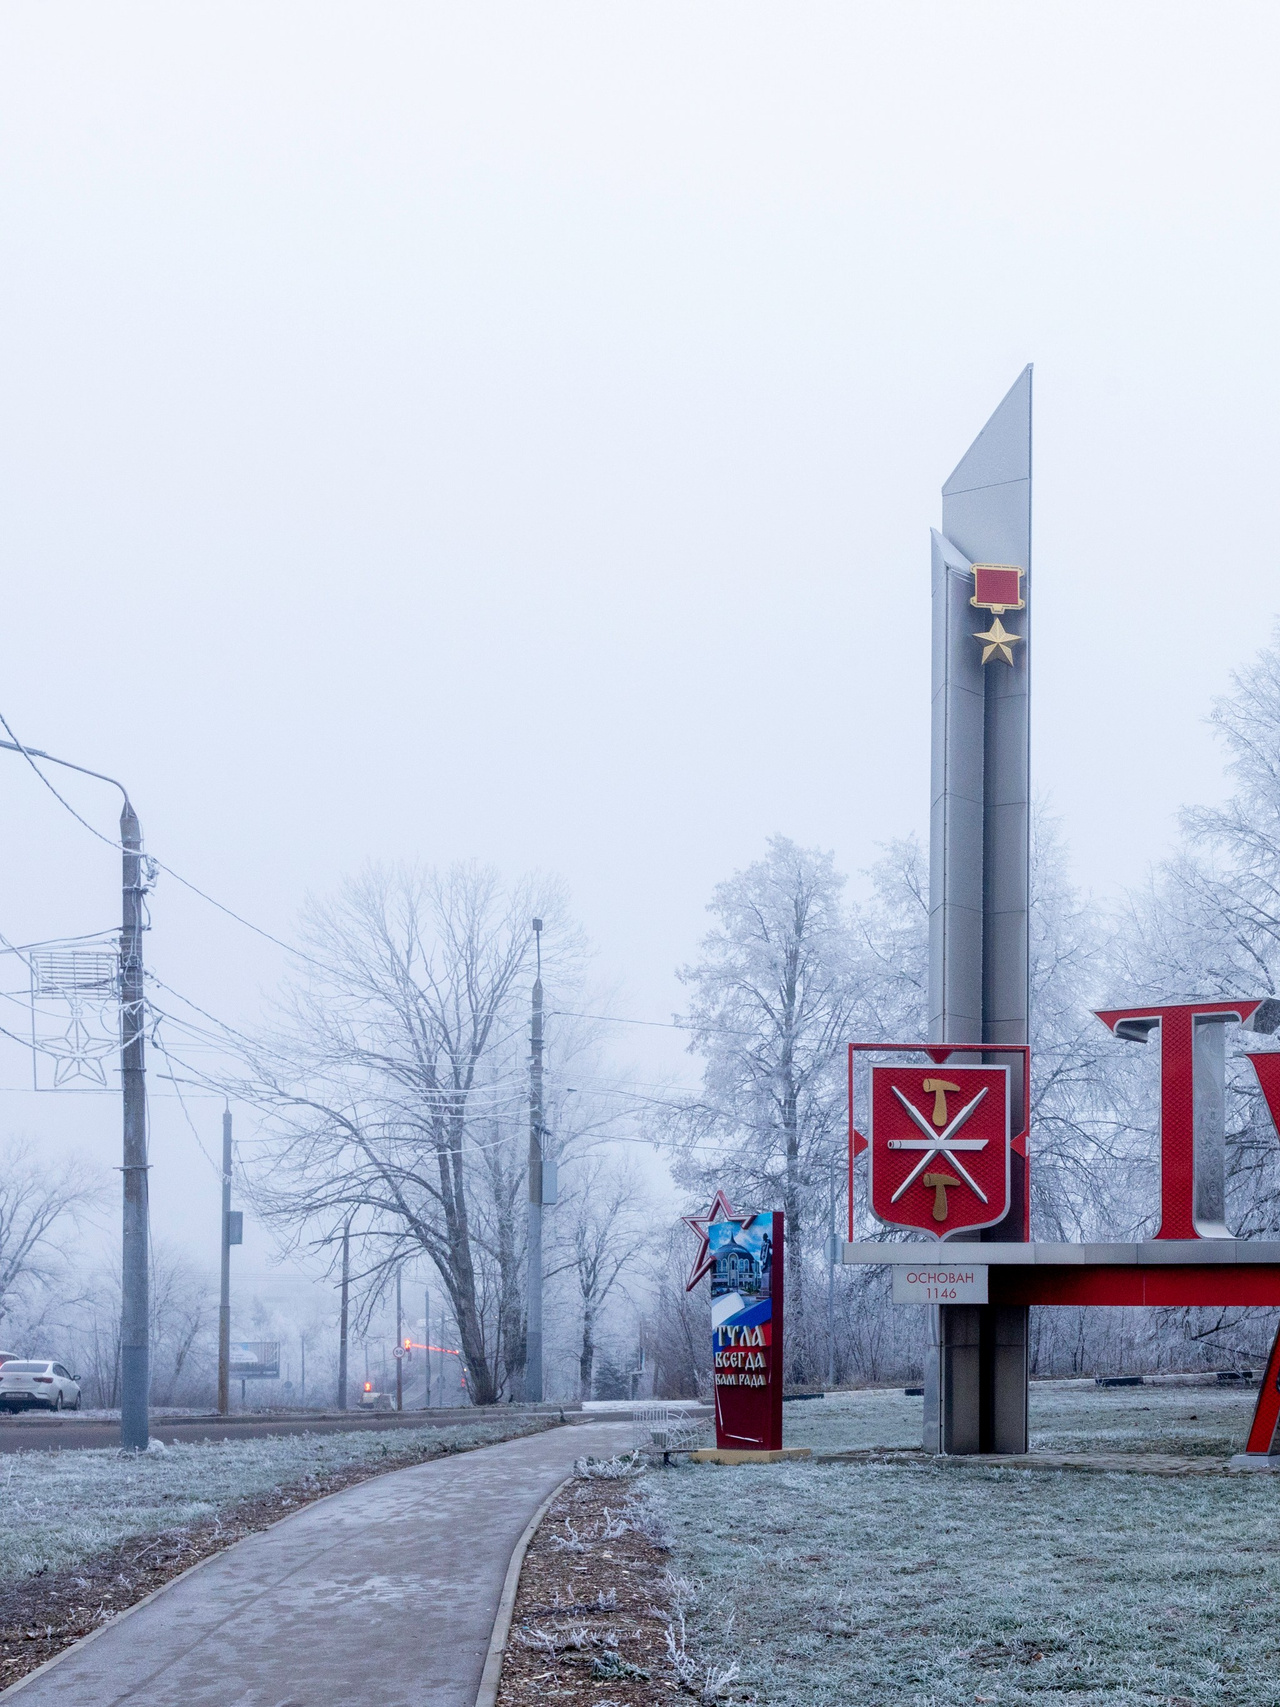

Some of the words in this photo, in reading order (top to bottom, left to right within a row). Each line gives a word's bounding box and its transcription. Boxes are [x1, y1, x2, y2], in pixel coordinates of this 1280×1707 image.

[906, 1272, 974, 1284] ОСНОВАН
[927, 1287, 957, 1299] 1146
[714, 1324, 766, 1347] ТУЛА
[715, 1351, 766, 1371] ВСЕГДА
[715, 1373, 738, 1386] ВАМ
[738, 1373, 766, 1388] РАДА
